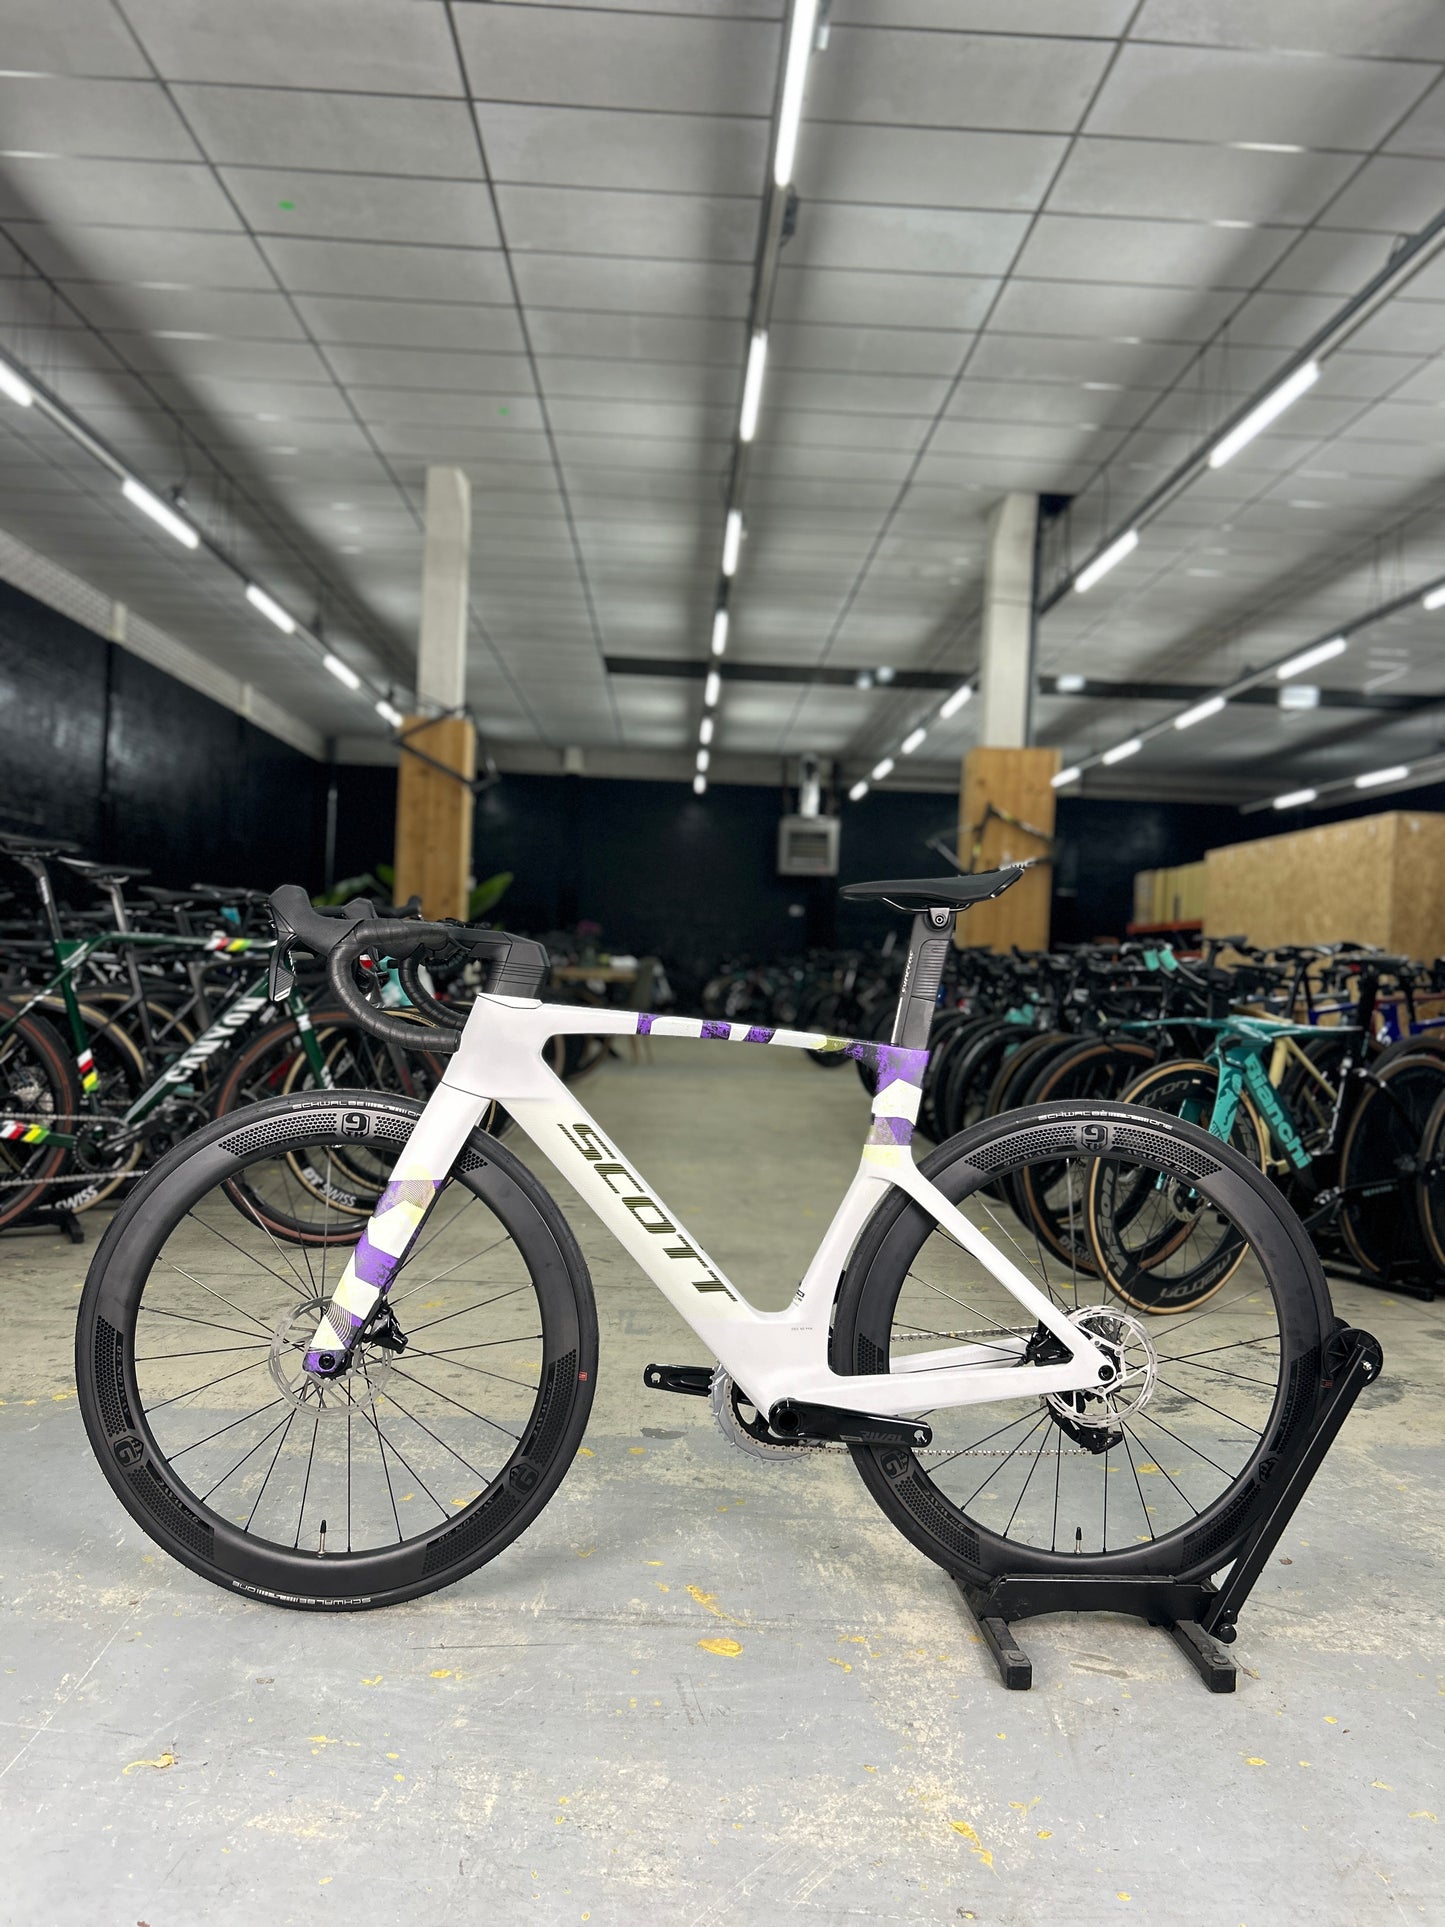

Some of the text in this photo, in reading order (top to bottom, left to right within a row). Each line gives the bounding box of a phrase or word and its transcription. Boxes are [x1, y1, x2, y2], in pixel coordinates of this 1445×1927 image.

[164, 997, 267, 1082] CANYON
[292, 1100, 365, 1110] SCHWALBE
[1038, 1110, 1108, 1121] SCHWALBE
[1244, 1053, 1313, 1169] Bianchi
[302, 1166, 357, 1207] DT SWISS
[557, 1123, 738, 1302] SCOTT
[299, 1597, 372, 1606] SCHWALBE
